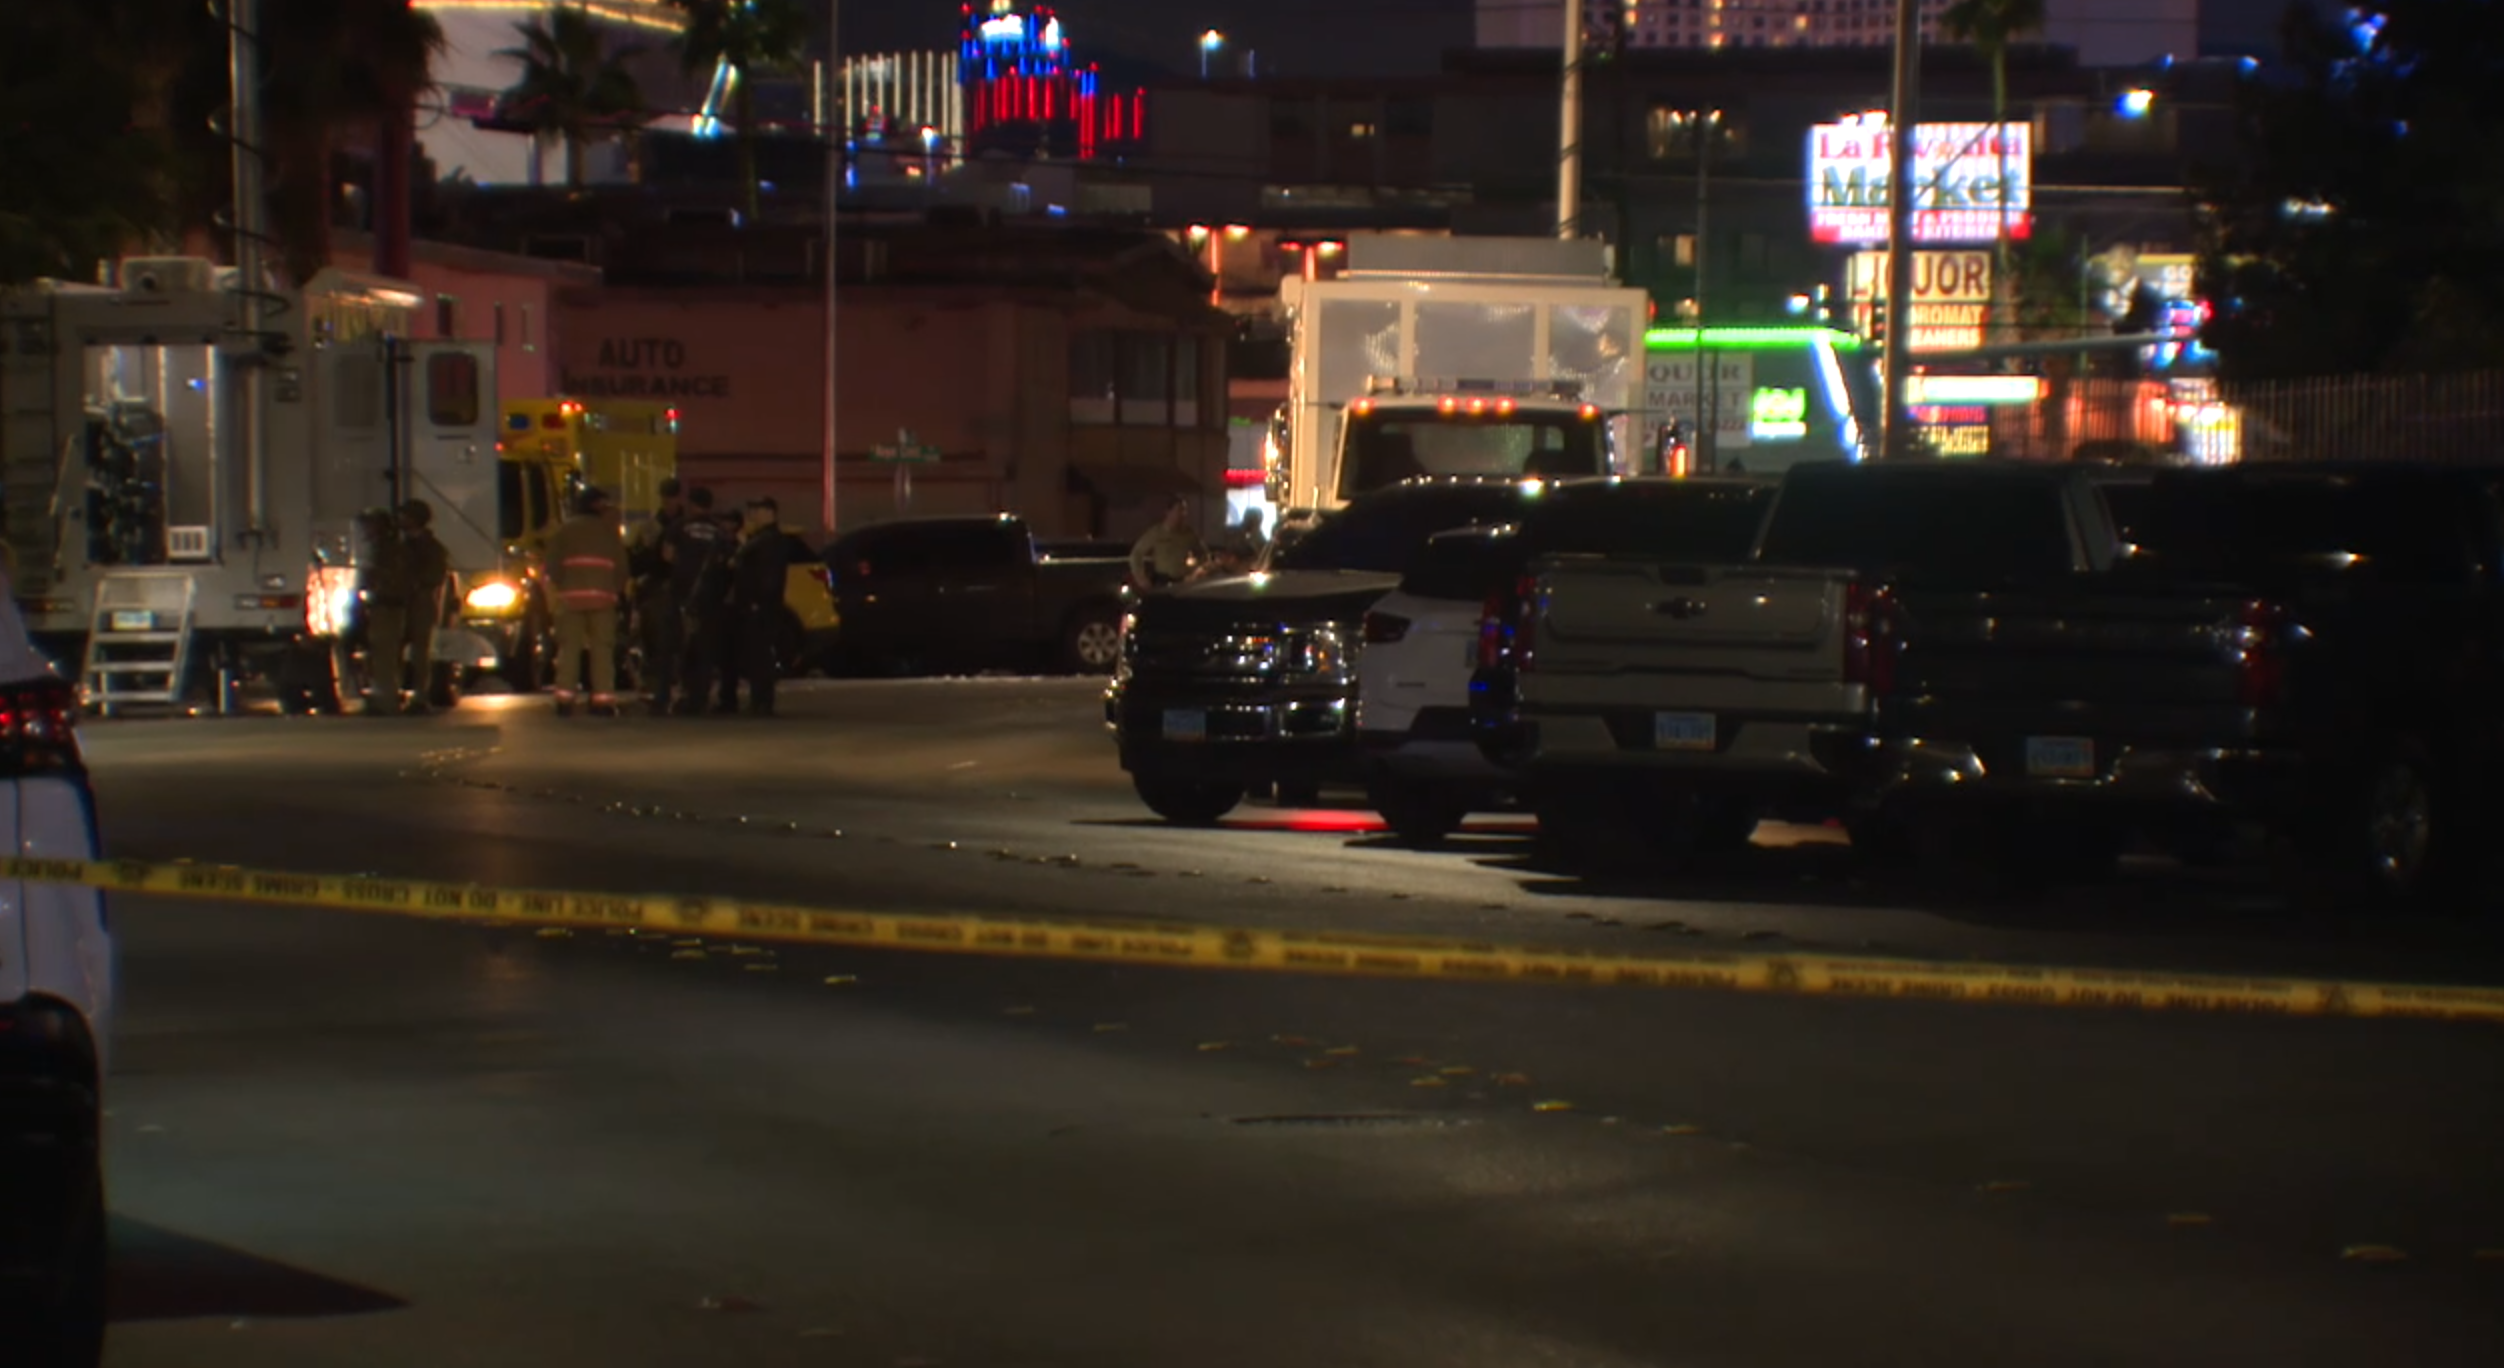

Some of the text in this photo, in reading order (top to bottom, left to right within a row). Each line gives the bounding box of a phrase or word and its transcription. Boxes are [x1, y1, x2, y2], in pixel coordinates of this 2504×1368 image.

[1819, 132, 1862, 159] La
[1851, 252, 1985, 297] LIUOR
[599, 337, 684, 369] AUTO
[1648, 391, 1742, 407] MARKT
